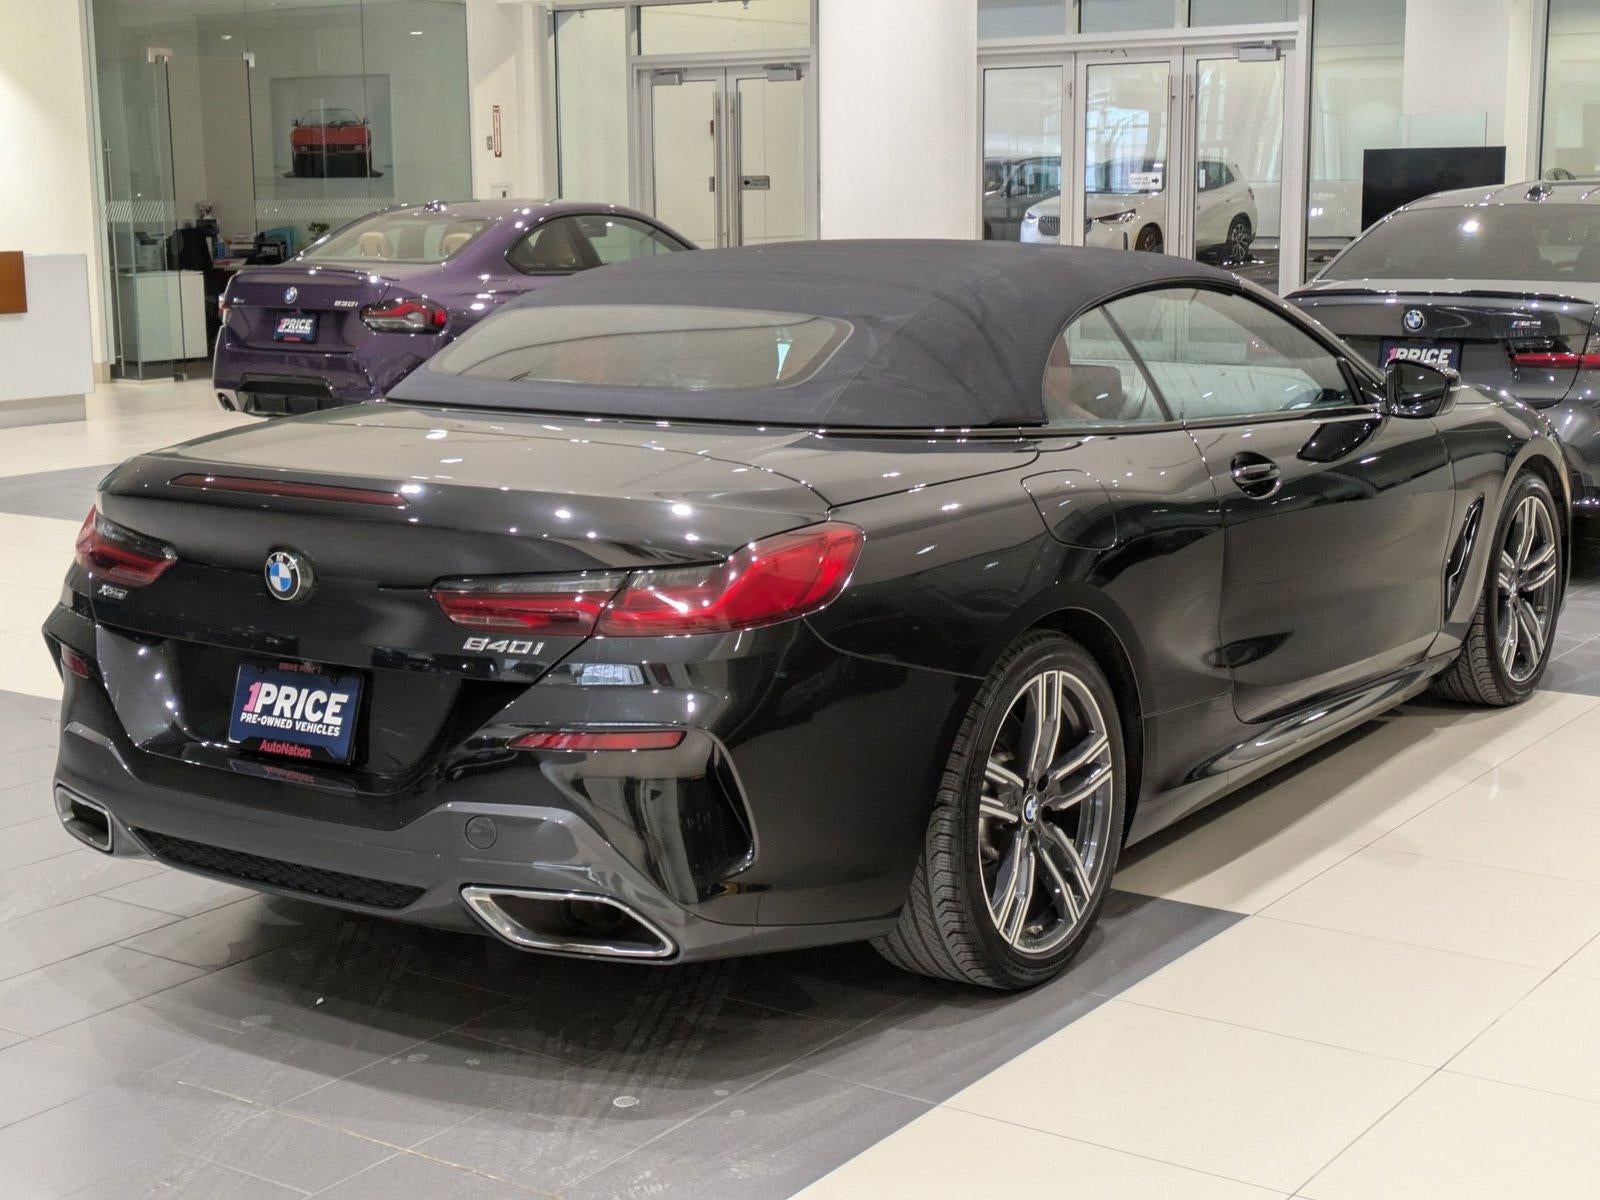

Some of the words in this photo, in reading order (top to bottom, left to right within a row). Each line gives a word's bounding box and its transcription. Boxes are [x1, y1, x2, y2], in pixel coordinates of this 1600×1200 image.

[278, 318, 314, 331] 1PRICE
[1387, 347, 1452, 364] 1PRICE
[243, 681, 349, 726] 1PRICE
[240, 712, 293, 731] PRE-OWNED
[295, 721, 340, 737] VEHICLES
[259, 740, 312, 758] AutoNation
